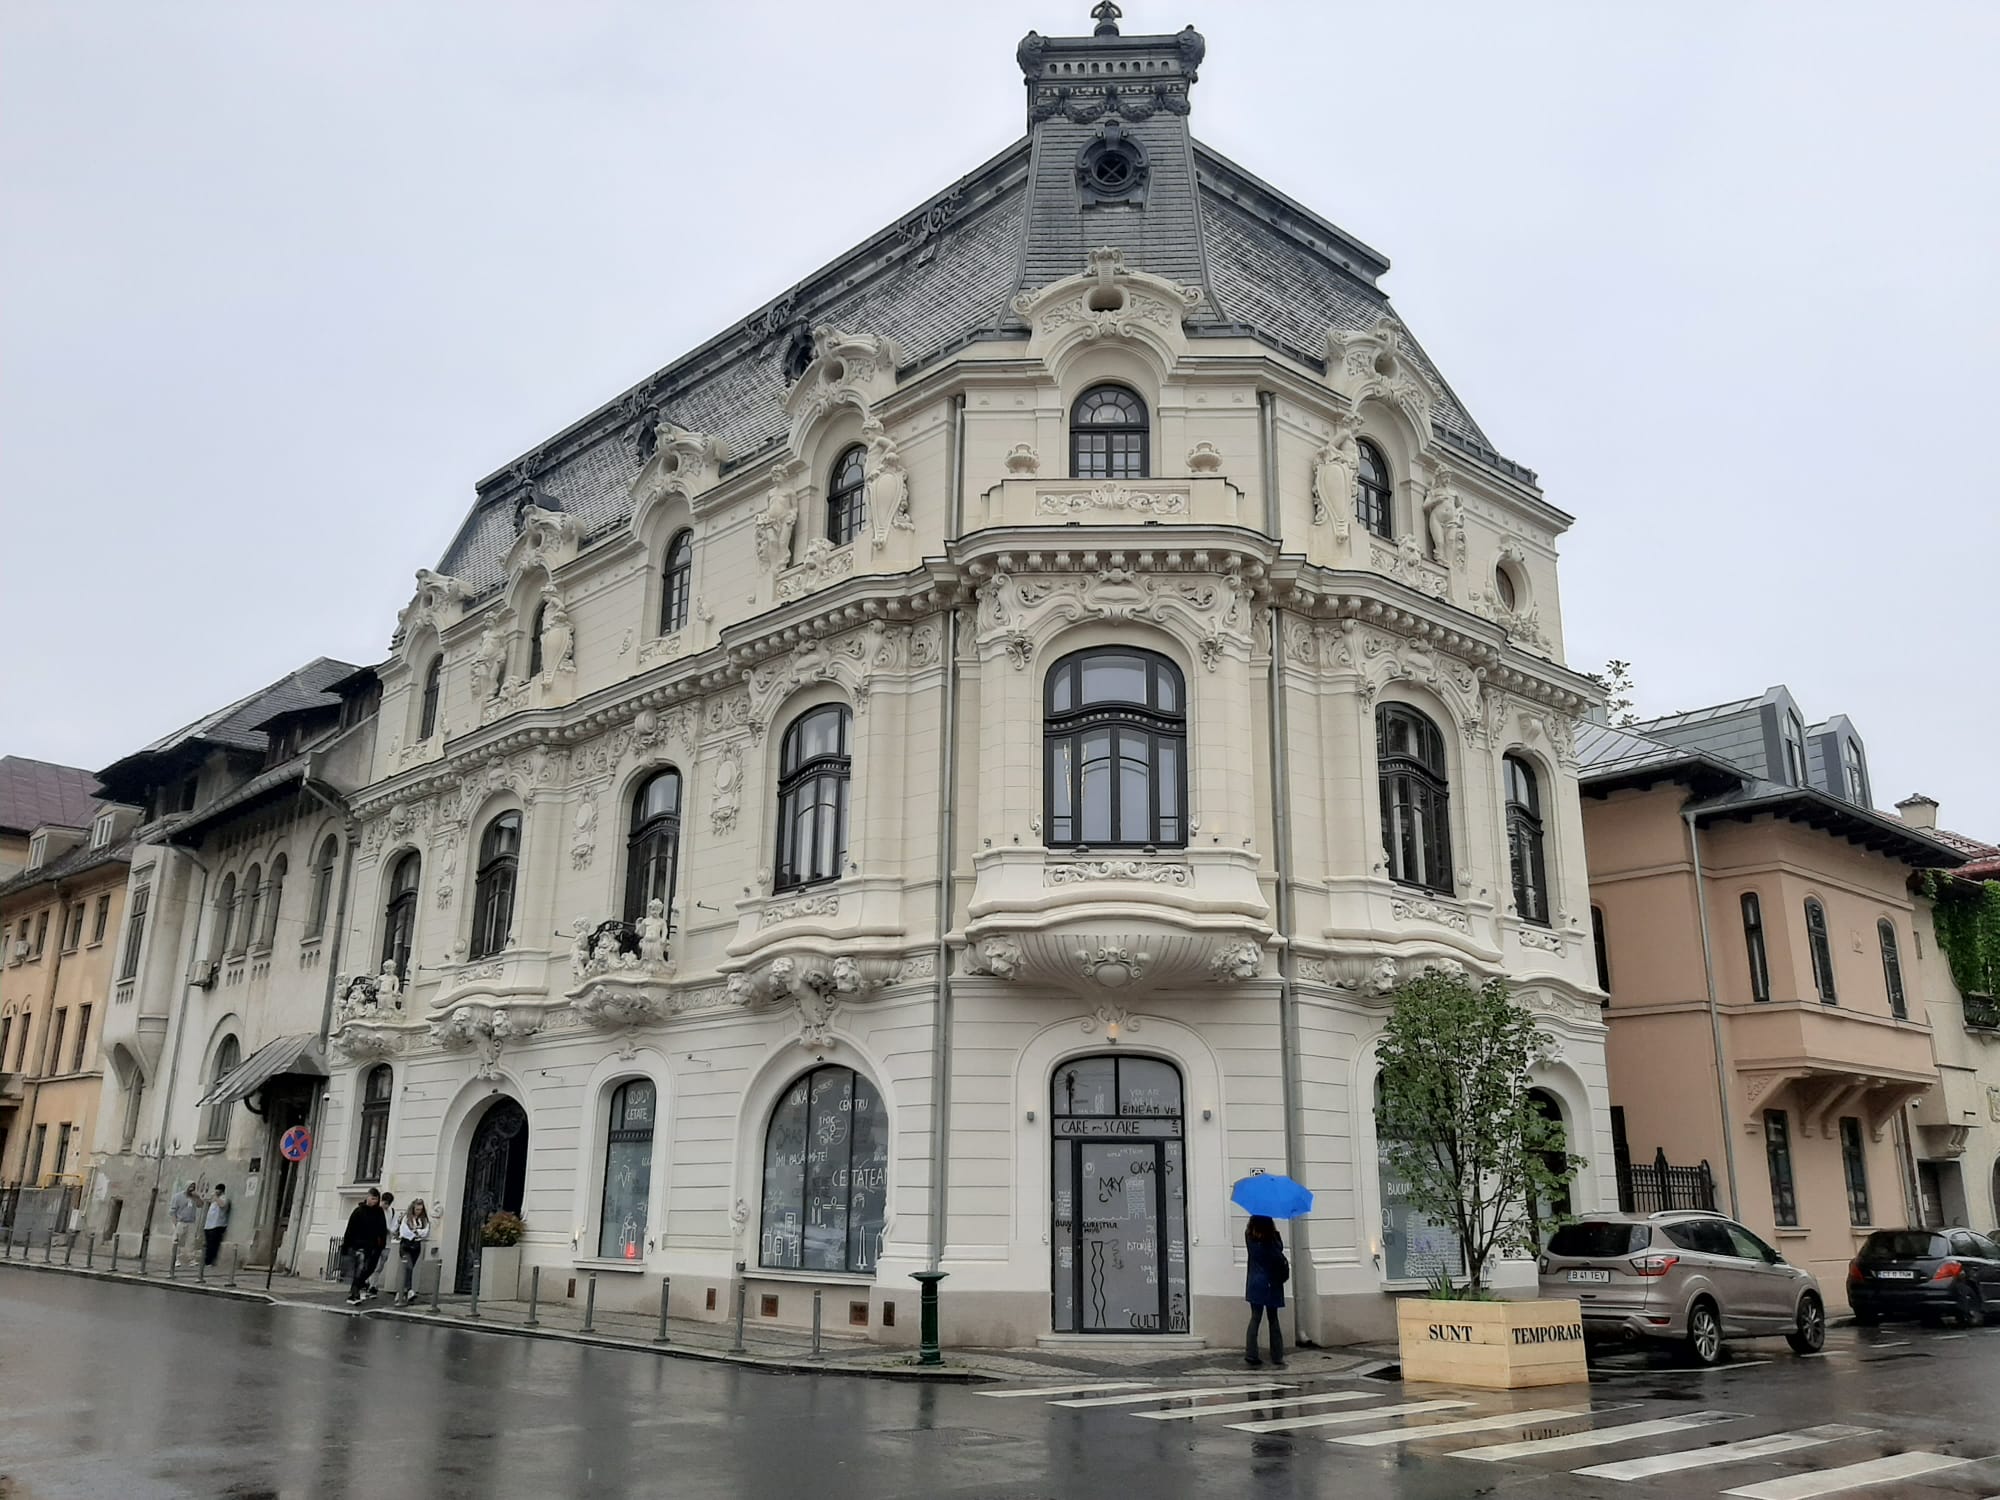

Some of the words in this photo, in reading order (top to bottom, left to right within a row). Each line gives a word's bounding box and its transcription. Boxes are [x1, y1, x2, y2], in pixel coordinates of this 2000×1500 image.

[1061, 1120, 1089, 1134] CARE
[1103, 1120, 1140, 1135] SCARE
[1573, 1271, 1577, 1279] B
[1428, 1324, 1473, 1342] SUNT
[1511, 1323, 1582, 1345] TEMPORAR
